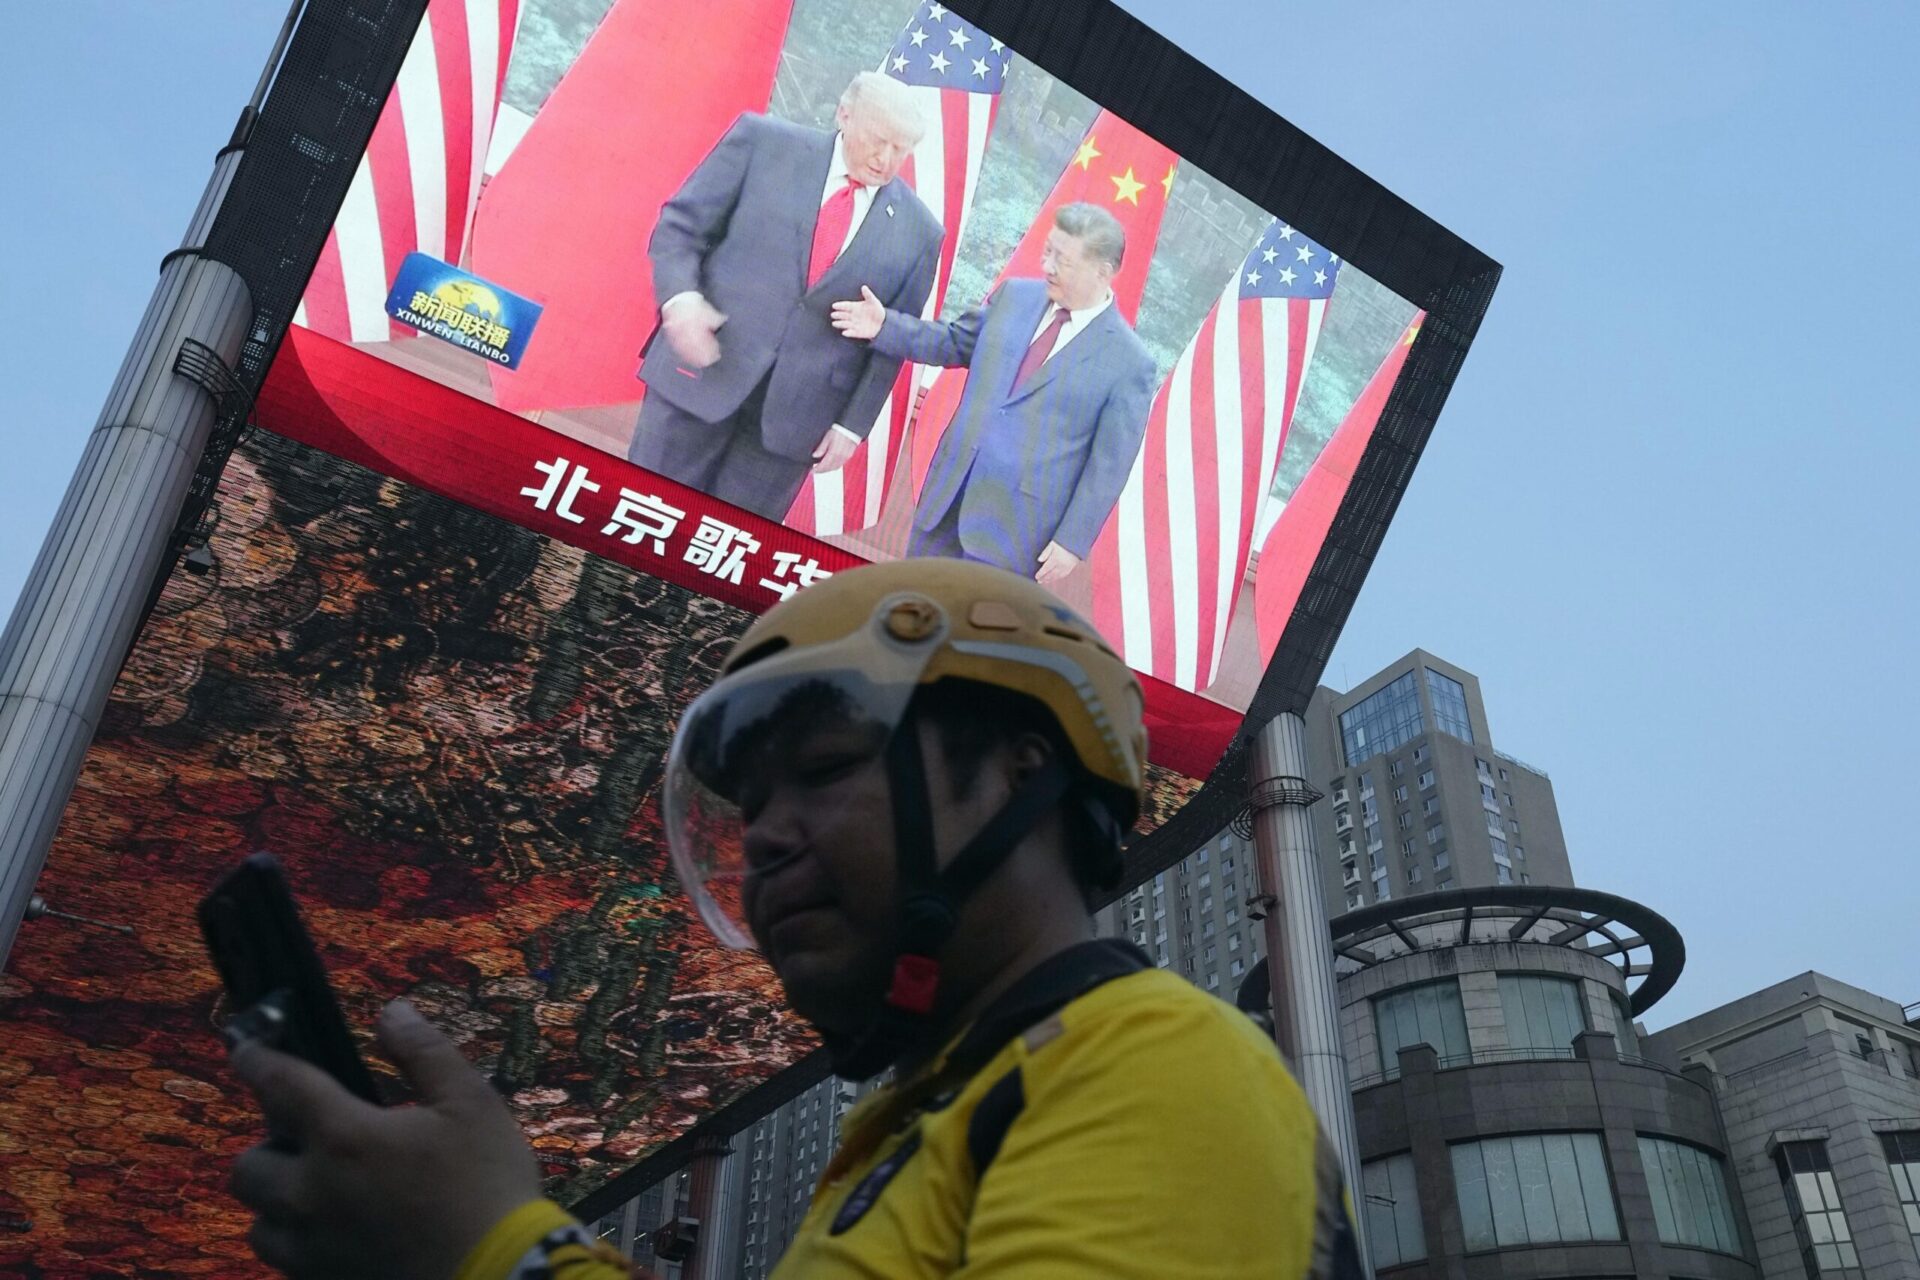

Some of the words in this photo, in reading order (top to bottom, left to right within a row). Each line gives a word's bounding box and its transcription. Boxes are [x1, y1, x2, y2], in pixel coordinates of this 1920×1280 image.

[396, 308, 453, 339] XINWEN
[460, 335, 510, 363] LIANBO
[410, 291, 511, 349] 新闻联播
